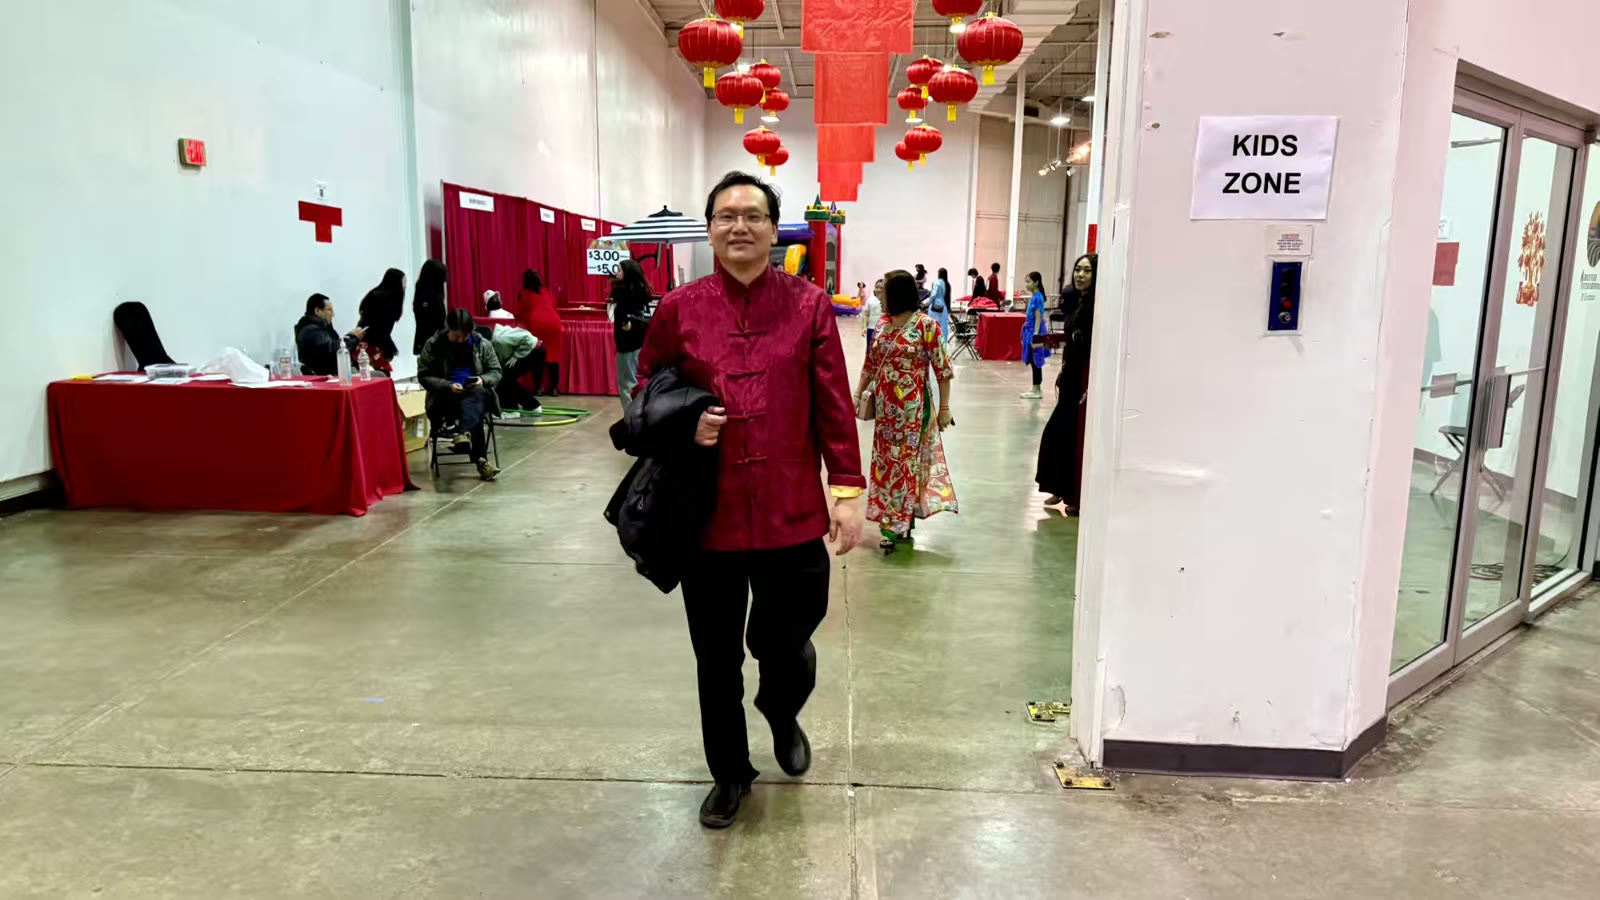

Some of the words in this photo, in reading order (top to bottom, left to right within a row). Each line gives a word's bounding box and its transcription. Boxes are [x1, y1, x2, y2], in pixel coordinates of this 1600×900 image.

[1232, 134, 1298, 156] KIDS
[1222, 172, 1302, 194] ZONE
[589, 250, 620, 261] $3.00
